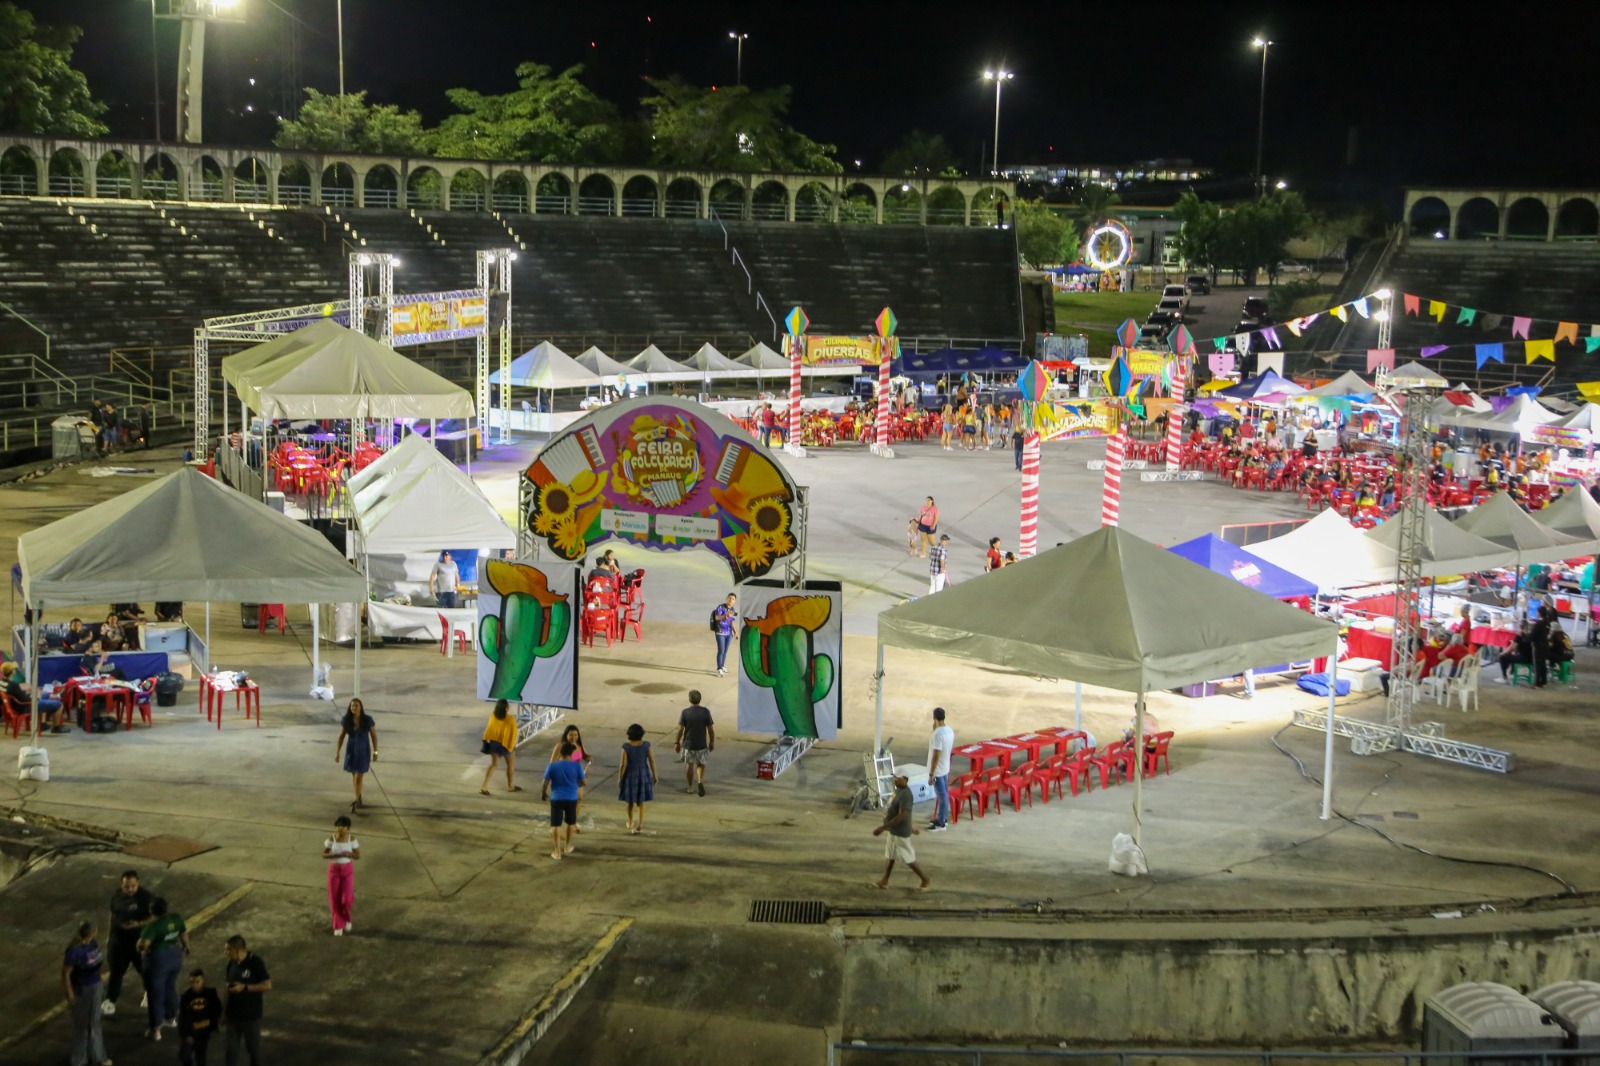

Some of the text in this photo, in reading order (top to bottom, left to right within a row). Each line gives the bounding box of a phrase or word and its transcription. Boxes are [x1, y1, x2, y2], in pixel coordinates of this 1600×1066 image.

[637, 441, 683, 455] FEIRA
[631, 453, 692, 468] FOLCLÓRICA
[647, 472, 682, 480] MANAUS
